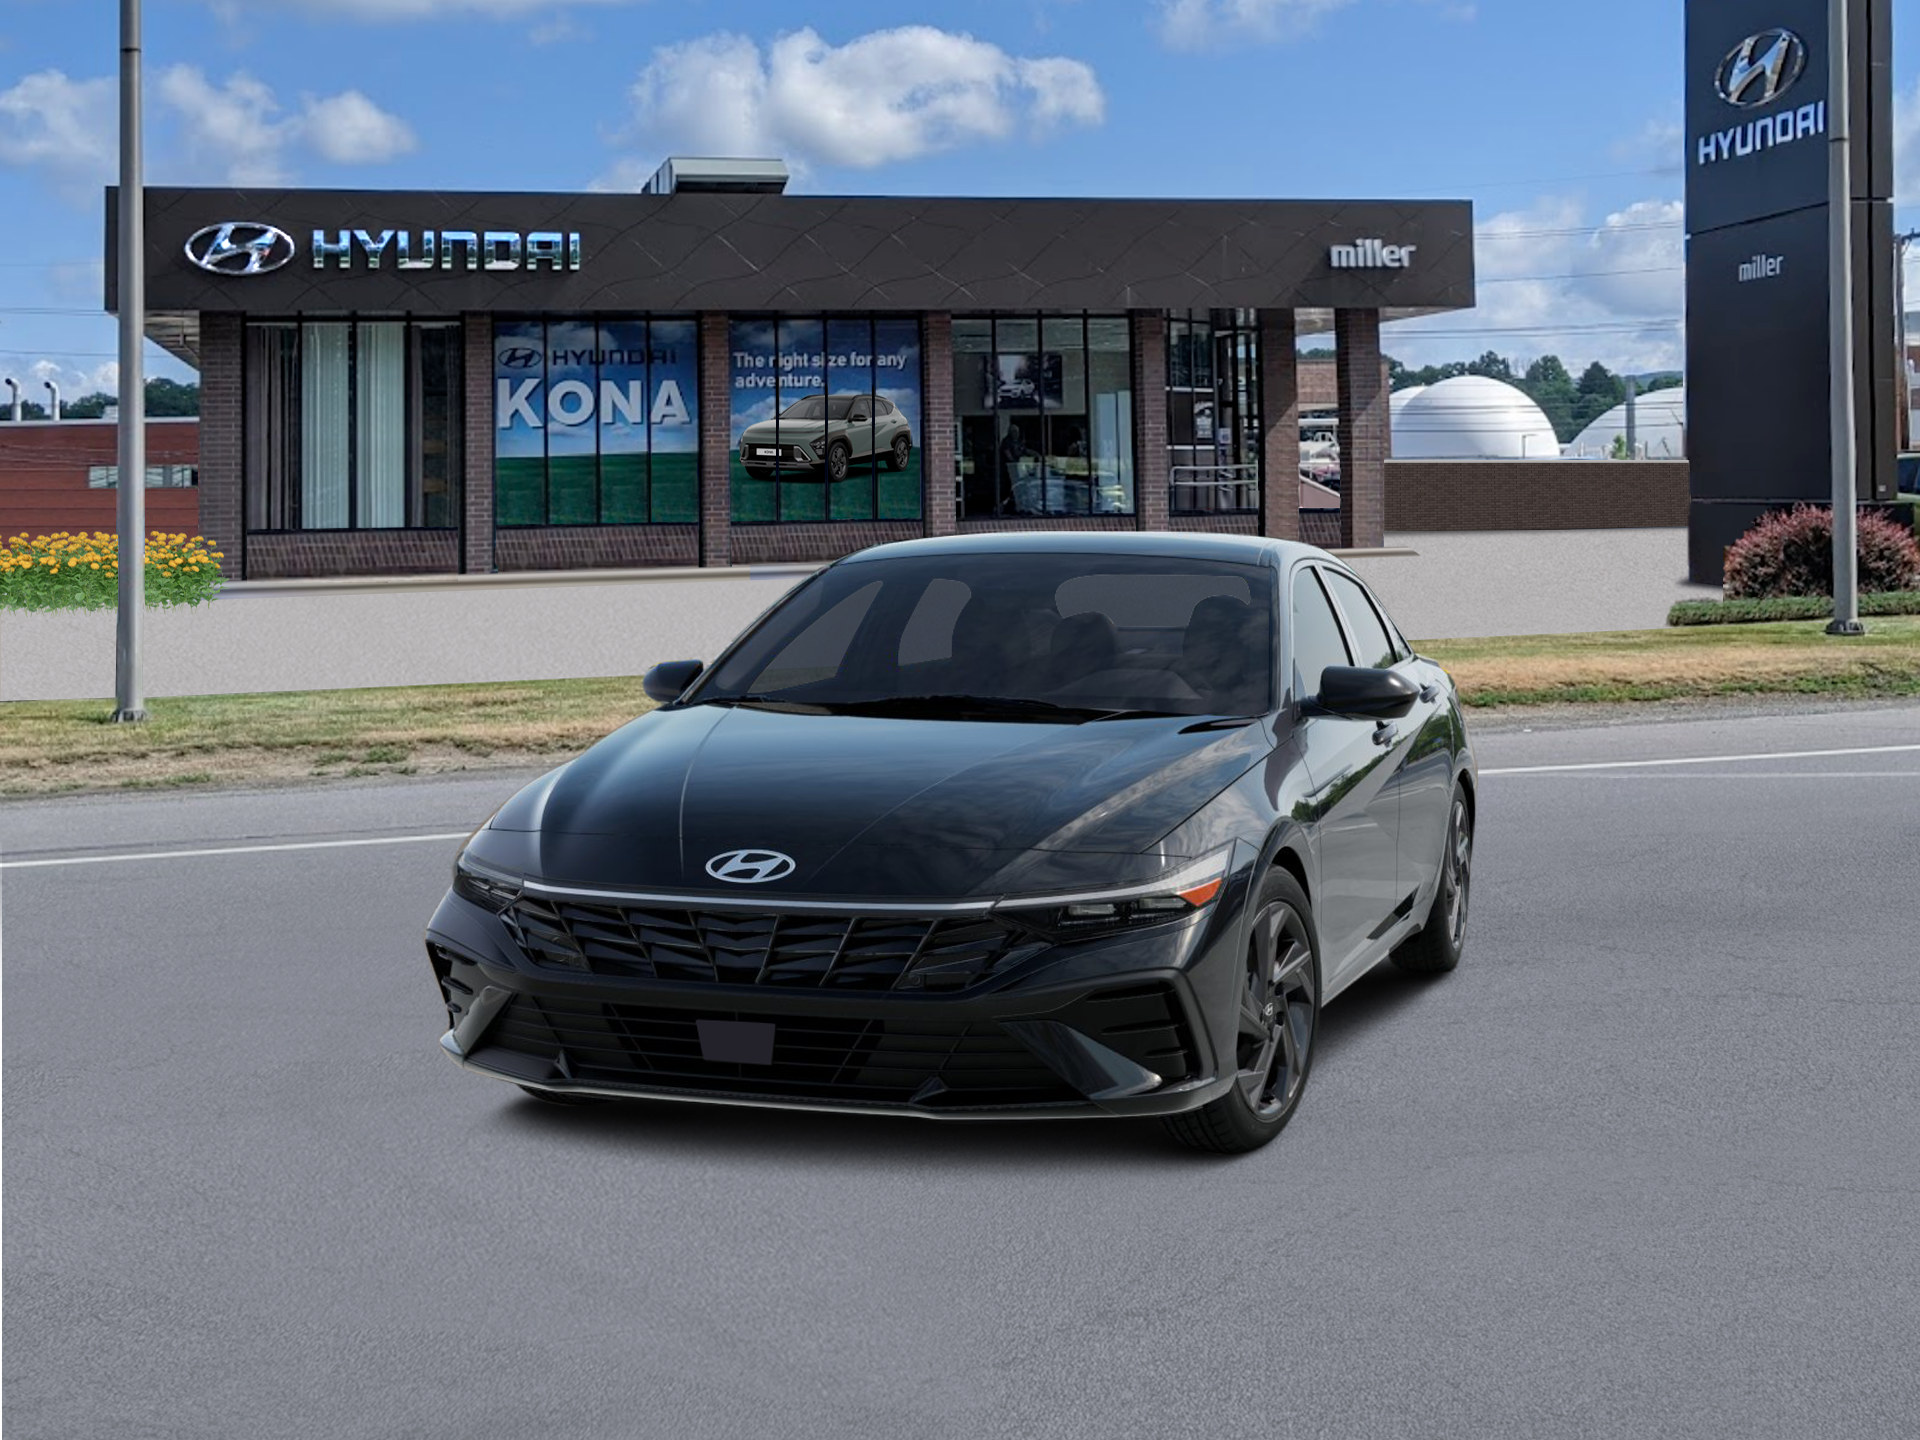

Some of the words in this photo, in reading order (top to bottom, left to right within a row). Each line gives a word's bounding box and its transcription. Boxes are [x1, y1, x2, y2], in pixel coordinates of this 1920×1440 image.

[1698, 101, 1825, 165] HYUNDAI
[312, 229, 582, 271] HYUNDAI
[1330, 238, 1418, 268] miller
[1739, 254, 1783, 281] miller
[552, 349, 677, 366] HYUNDAI
[732, 352, 766, 369] The
[768, 352, 809, 371] right
[811, 352, 848, 367] size
[850, 351, 873, 367] for
[877, 354, 908, 370] any
[734, 373, 826, 388] adventure.
[497, 377, 691, 429] KONA
